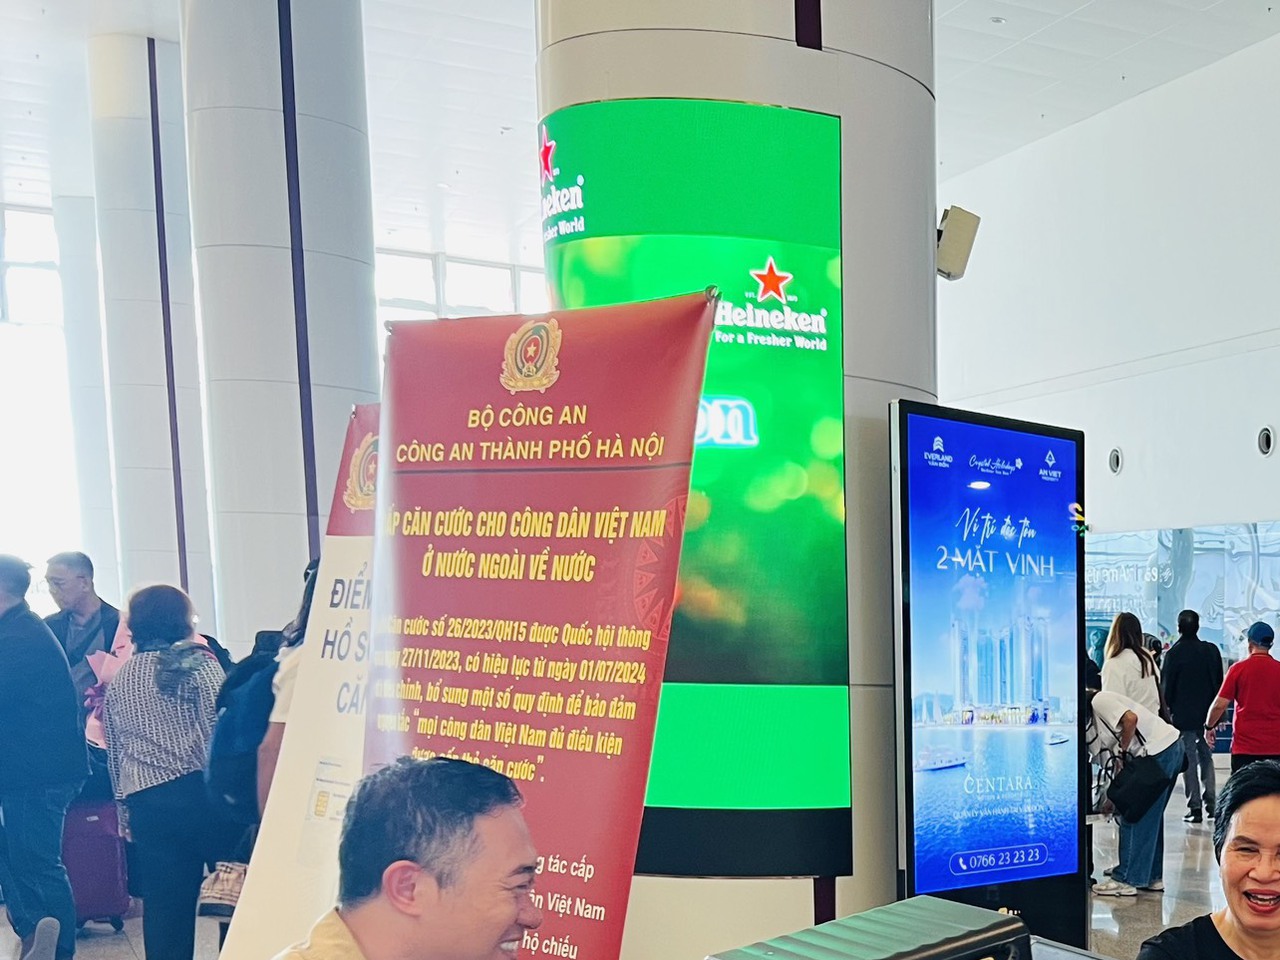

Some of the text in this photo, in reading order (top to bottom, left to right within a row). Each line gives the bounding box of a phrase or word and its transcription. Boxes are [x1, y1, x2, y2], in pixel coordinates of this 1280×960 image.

[714, 301, 826, 334] Heineken
[715, 331, 827, 351] For a Fresher World
[468, 402, 587, 431] BỘ CÔNG AN
[397, 431, 665, 462] CÔNG AN THÀNH PHỐ HÀ NỘI
[402, 506, 667, 544] CĂN CƯỚC CHO CÔNG DÂN VIỆT NAM
[422, 543, 595, 582] Ở NƯỚC NGOÀI VỀ NƯỚC
[936, 545, 1054, 577] 2 MẶT VINH
[320, 616, 353, 662] HỒ
[404, 613, 651, 652] cước số 26/2023/QH15 được Quốc hội thông
[401, 648, 646, 685] 27/11/2023, có hiệu lực từ ngày 01/07/2024
[964, 773, 1033, 794] CENTARA
[970, 849, 1039, 868] 0766 23 23 23
[575, 896, 606, 921] Nam
[541, 935, 578, 960] chiếu
